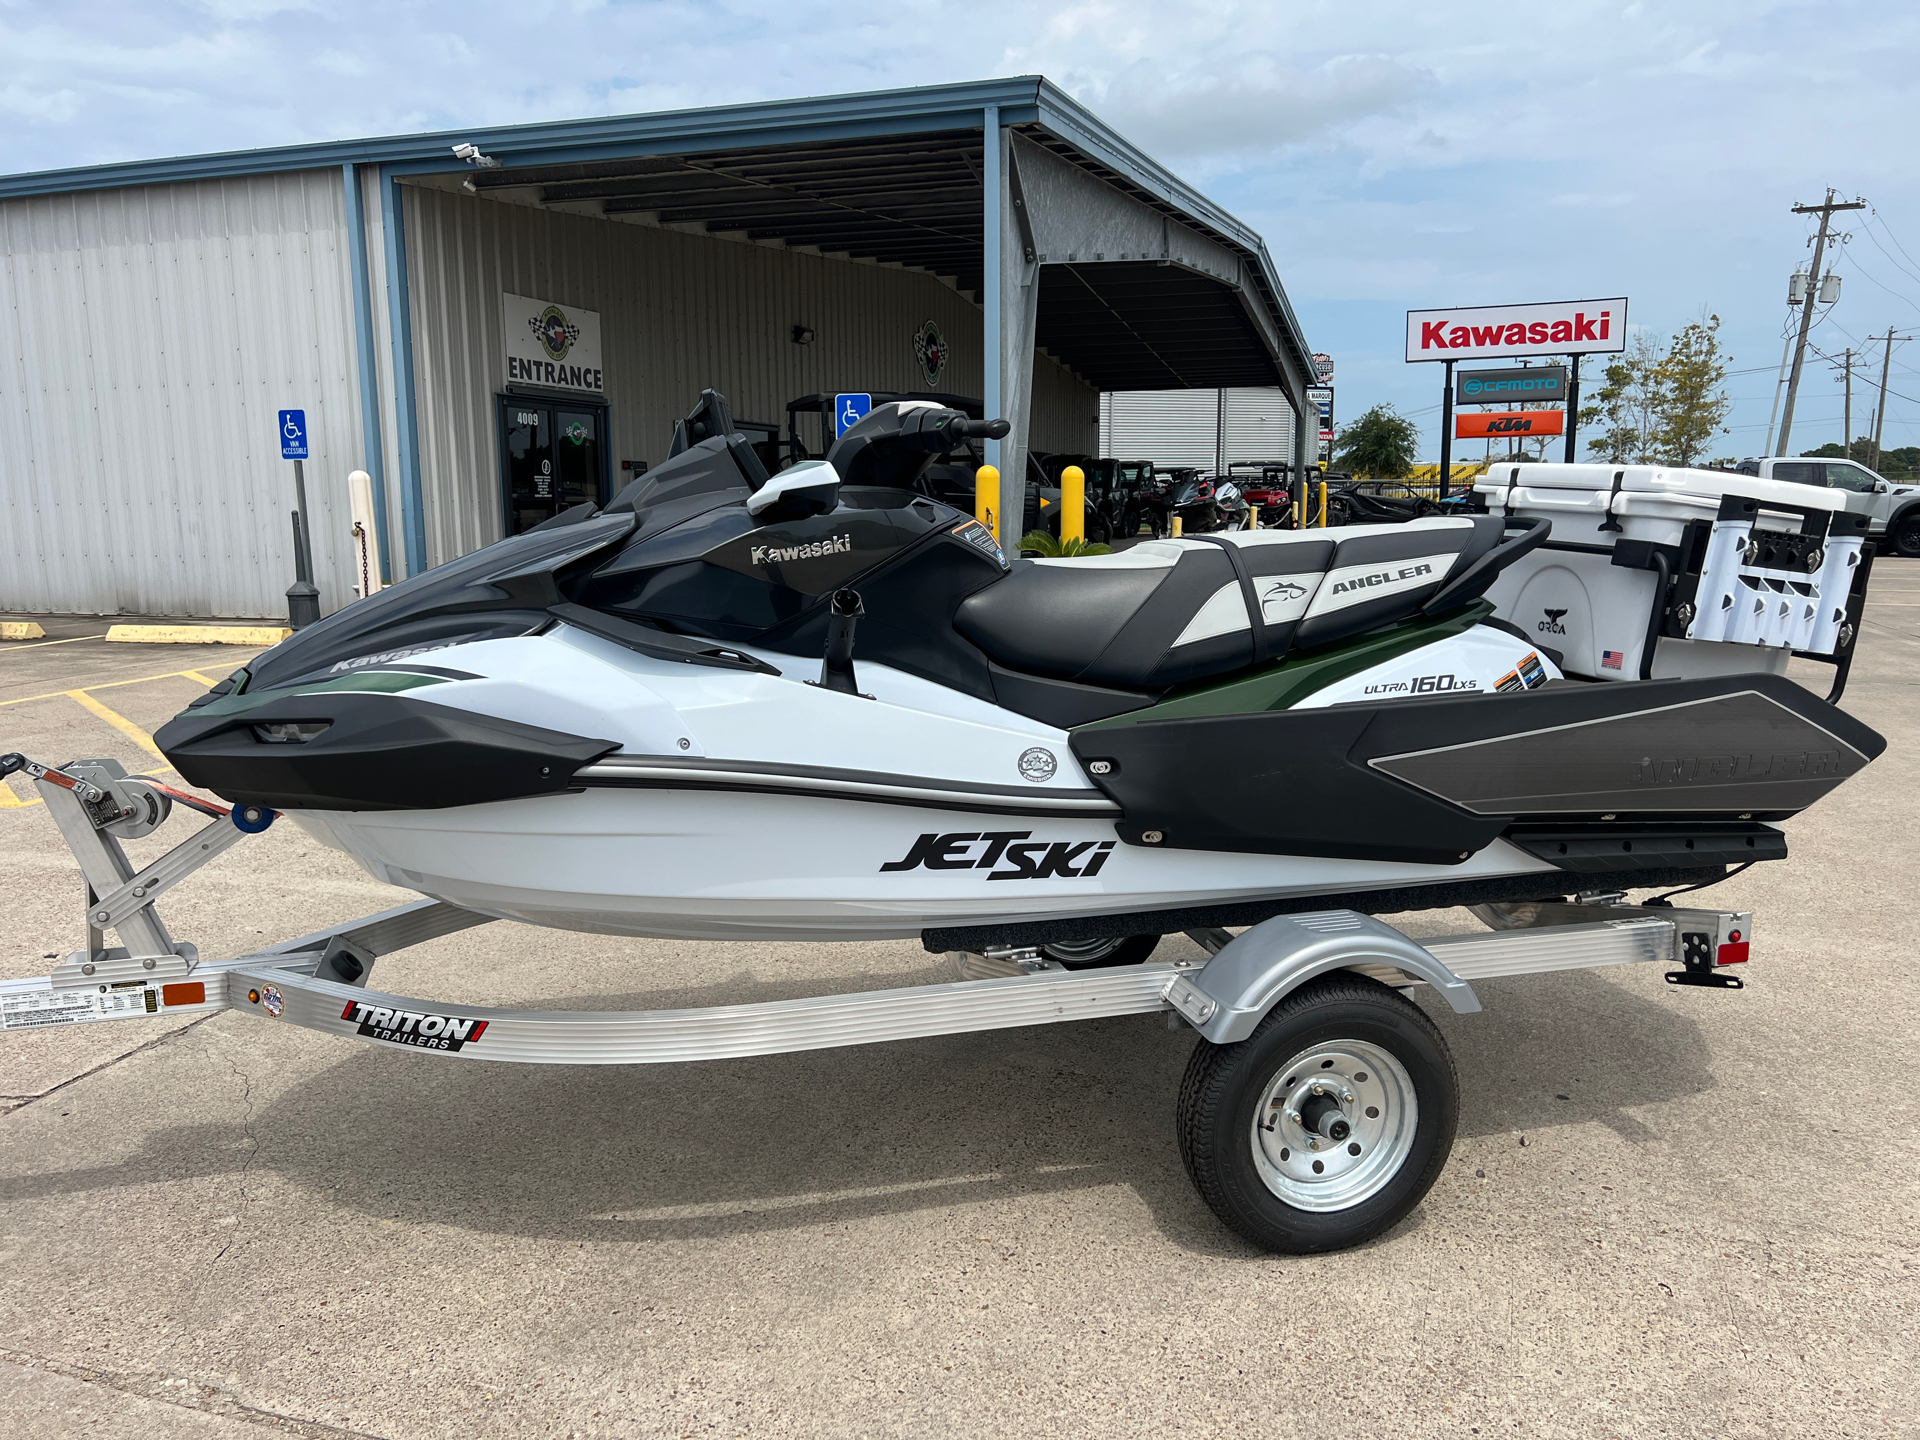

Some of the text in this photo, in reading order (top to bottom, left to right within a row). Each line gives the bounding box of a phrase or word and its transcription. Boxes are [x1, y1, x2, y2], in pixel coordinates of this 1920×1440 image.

[1421, 311, 1610, 349] Kawasaki
[508, 356, 602, 389] ENTRANCE
[1484, 378, 1558, 392] CFMOTO
[1311, 391, 1331, 400] MARQUE
[517, 412, 538, 426] 4009
[1486, 417, 1532, 432] KTM
[283, 447, 307, 455] ACCESSIBLE
[289, 440, 300, 448] VAN
[751, 533, 851, 565] Kawasaki
[1332, 563, 1432, 595] ANGLER
[1537, 621, 1566, 635] ORCA
[1364, 682, 1408, 694] ULTRA
[1615, 750, 1844, 785] ANGLER
[355, 1002, 474, 1041] TRITON
[373, 1028, 450, 1050] TRAILERS
